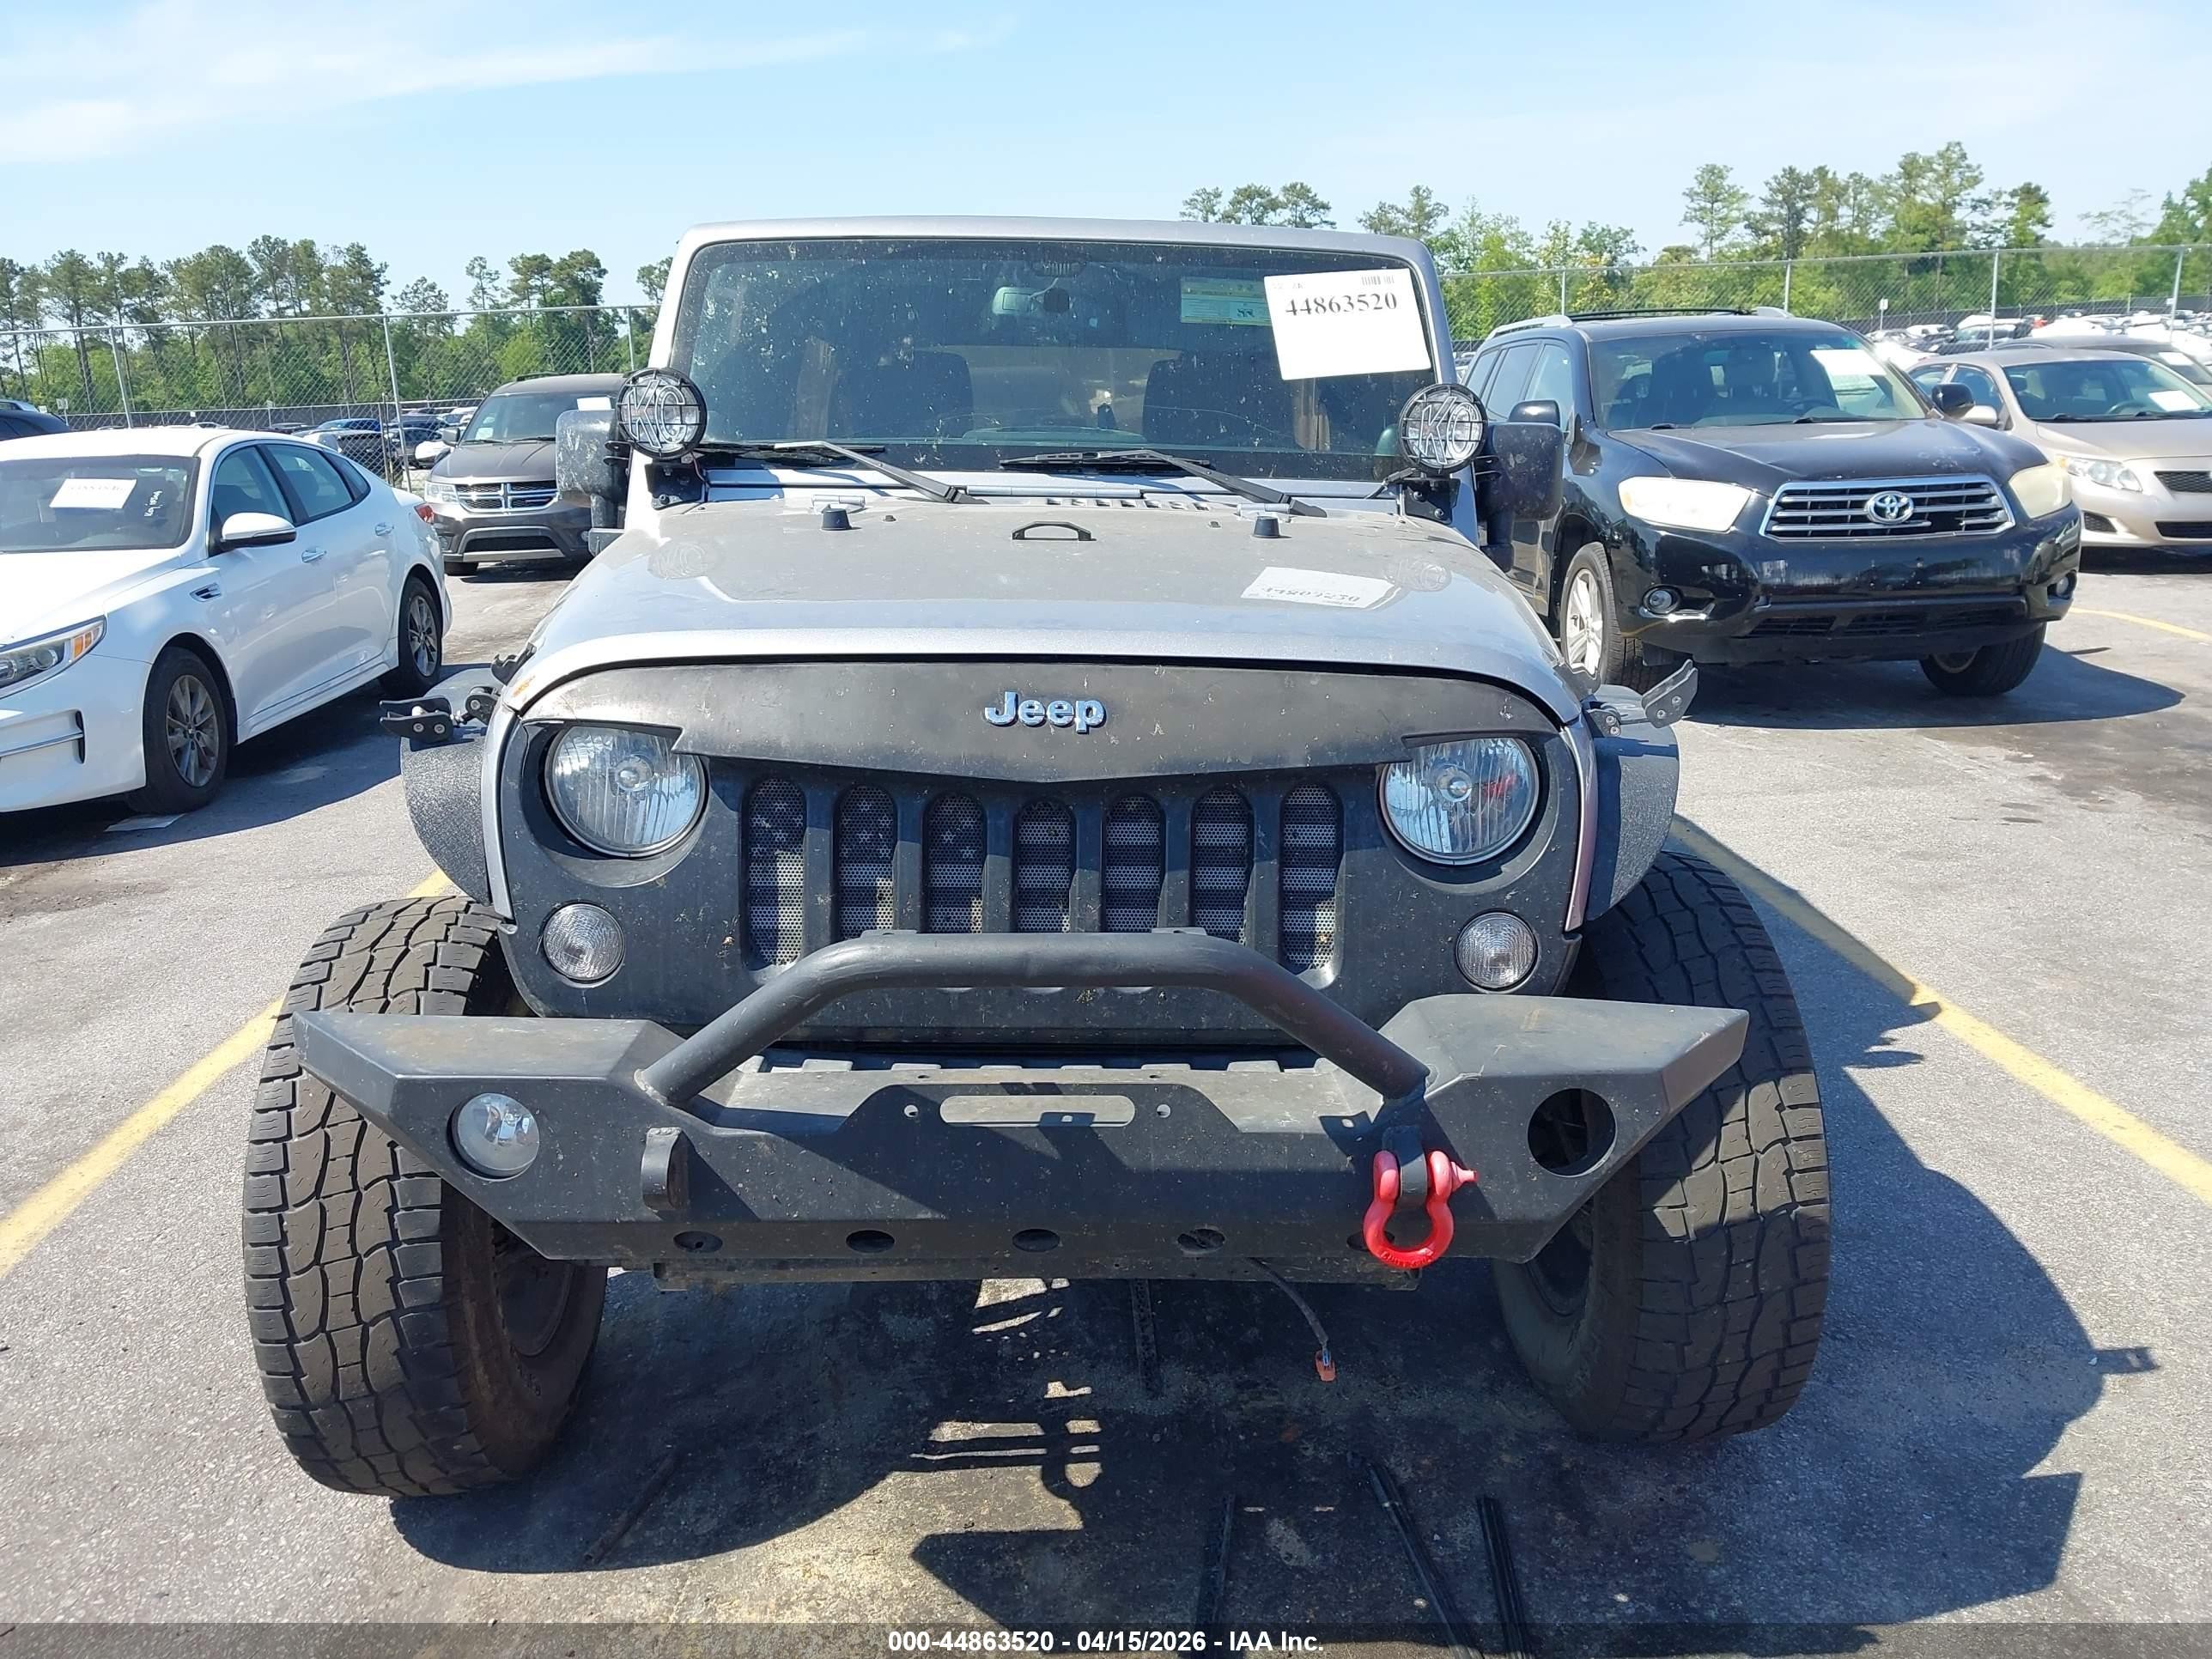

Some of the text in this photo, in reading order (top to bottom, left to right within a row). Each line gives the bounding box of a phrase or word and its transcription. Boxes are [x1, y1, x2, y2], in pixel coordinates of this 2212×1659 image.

[1285, 292, 1398, 316] 44863520
[627, 380, 687, 449] KC
[1419, 396, 1480, 465] KC
[984, 690, 1107, 734] Jeep
